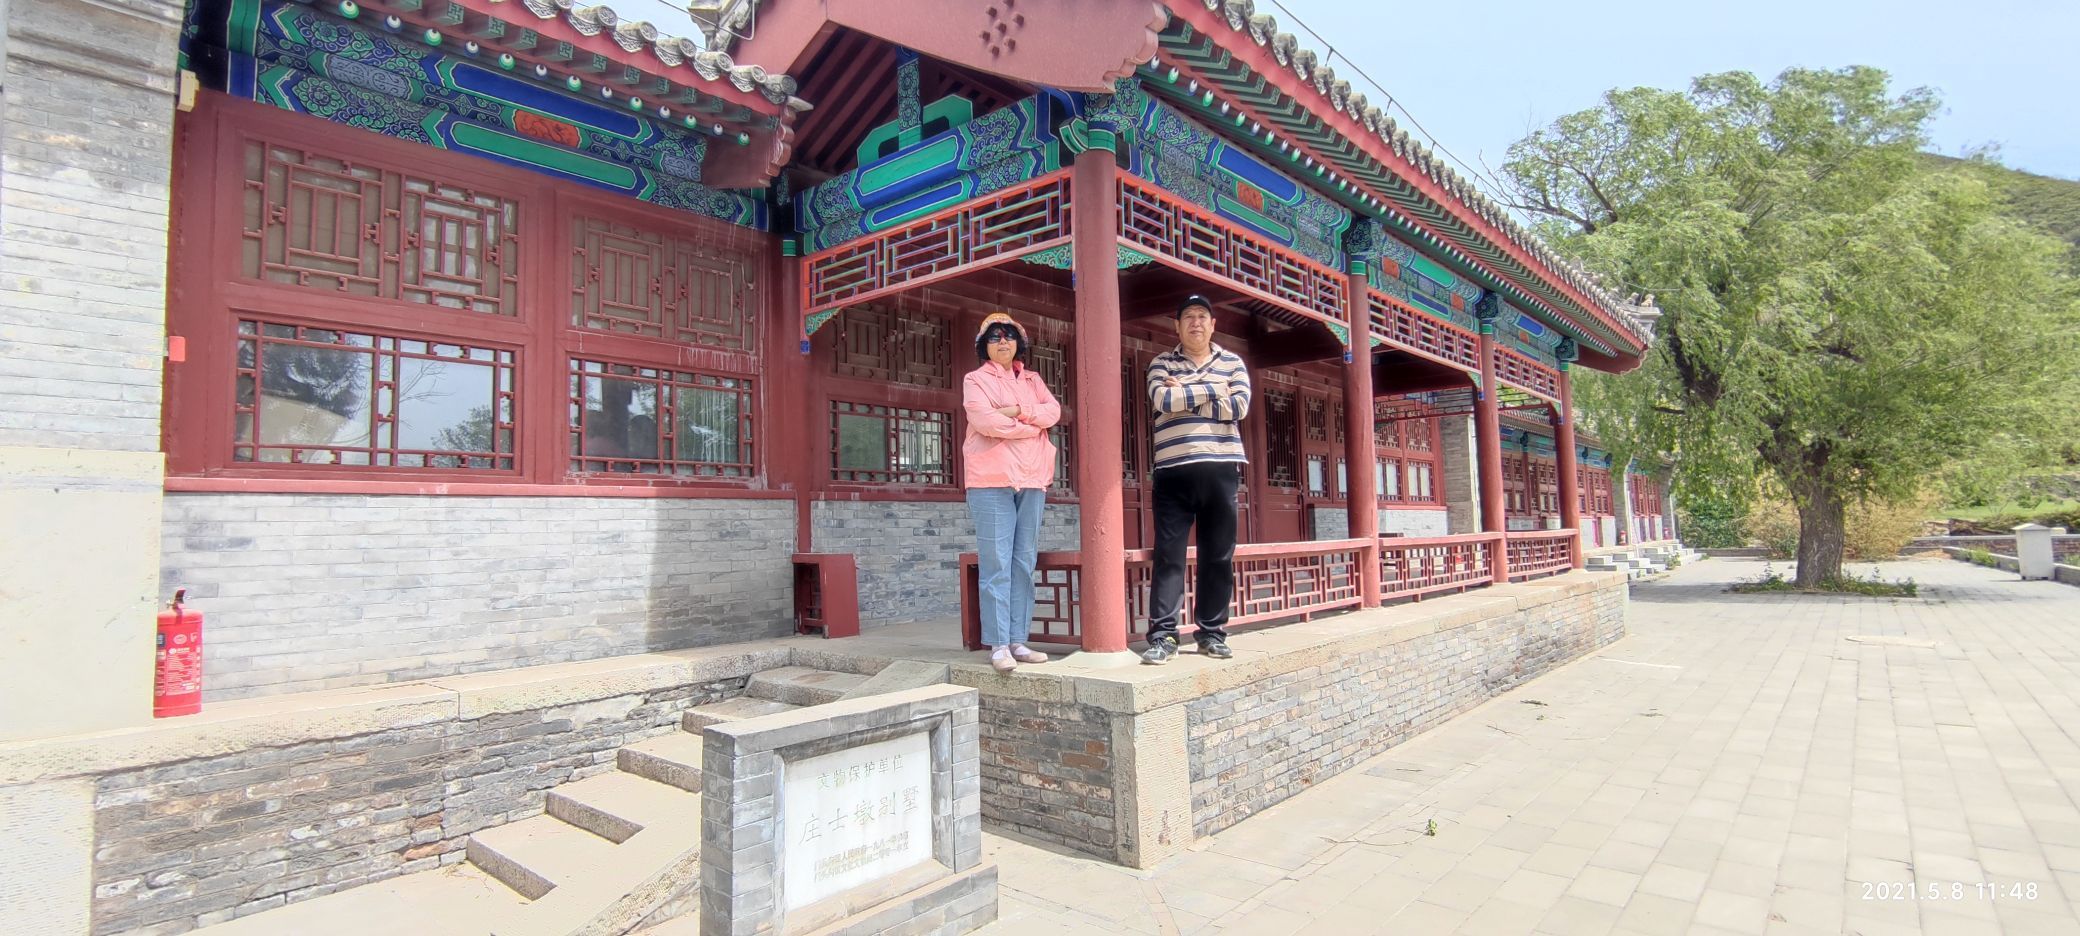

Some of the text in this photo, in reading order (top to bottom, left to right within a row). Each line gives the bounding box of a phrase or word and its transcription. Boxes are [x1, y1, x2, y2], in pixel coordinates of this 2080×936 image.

[817, 754, 904, 790] 文物保护单位
